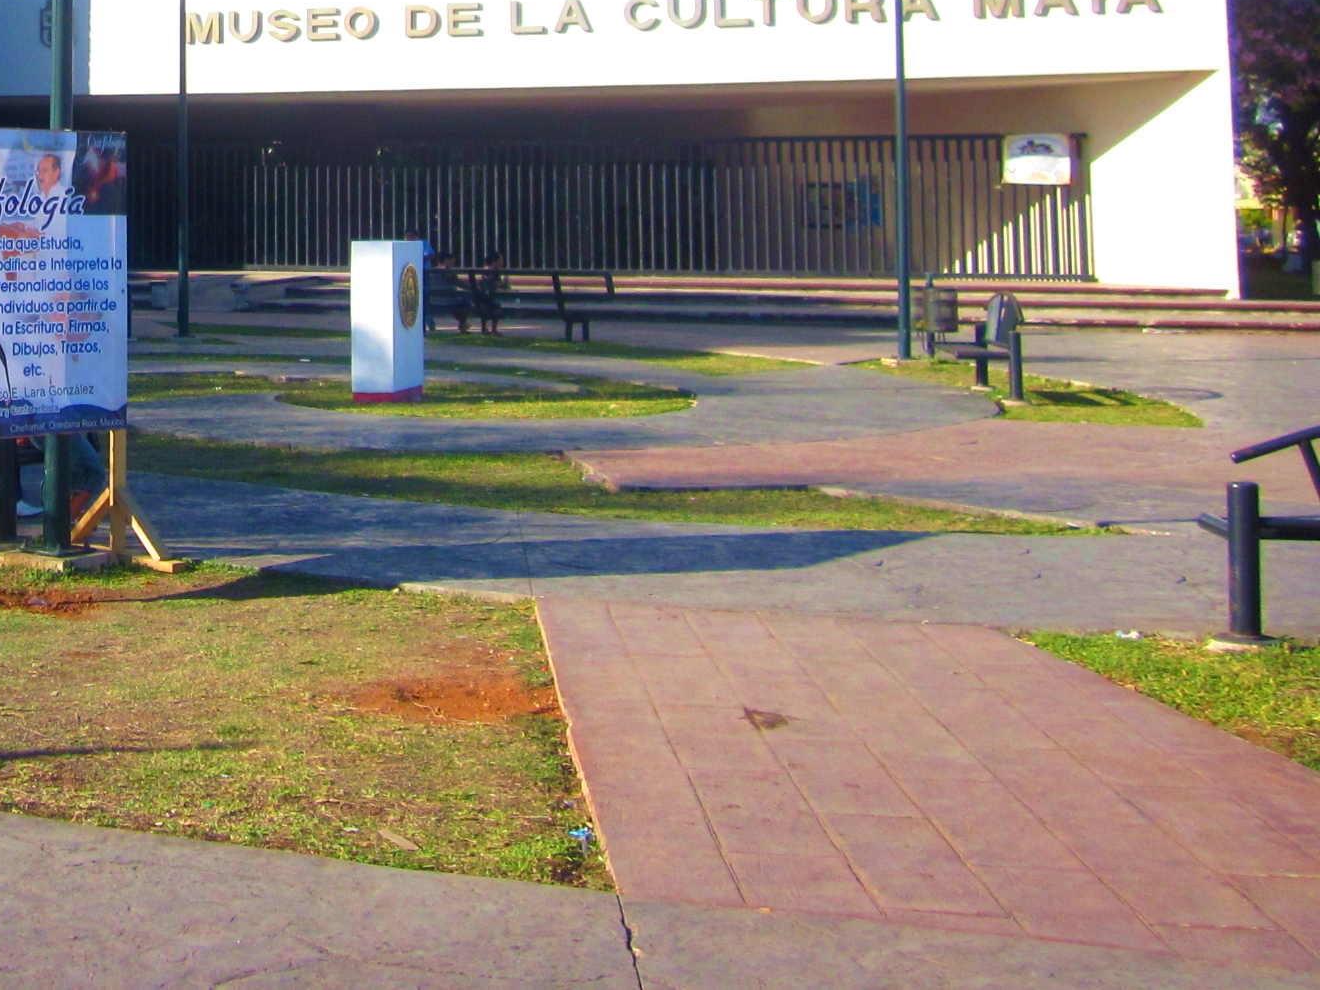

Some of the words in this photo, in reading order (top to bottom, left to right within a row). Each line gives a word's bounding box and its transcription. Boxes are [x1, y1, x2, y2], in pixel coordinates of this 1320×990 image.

[185, 6, 380, 45] MUSEO
[405, 2, 484, 38] DE
[16, 238, 38, 253] que
[40, 236, 84, 252] Estudia,
[38, 261, 47, 271] e
[51, 258, 109, 273] Interpreta
[111, 257, 122, 270] la
[74, 278, 91, 291] de
[92, 277, 109, 291] los
[56, 302, 65, 312] a
[67, 299, 98, 315] partir
[100, 298, 117, 311] de
[2, 322, 13, 335] la
[15, 320, 67, 335] Escritura,
[68, 319, 109, 334] Firmas,
[12, 342, 58, 357] Dibujos,
[60, 340, 101, 355] Trazos,
[23, 363, 46, 377] etc.
[11, 387, 21, 399] E.
[24, 387, 46, 398] Lara
[48, 384, 95, 397] González
